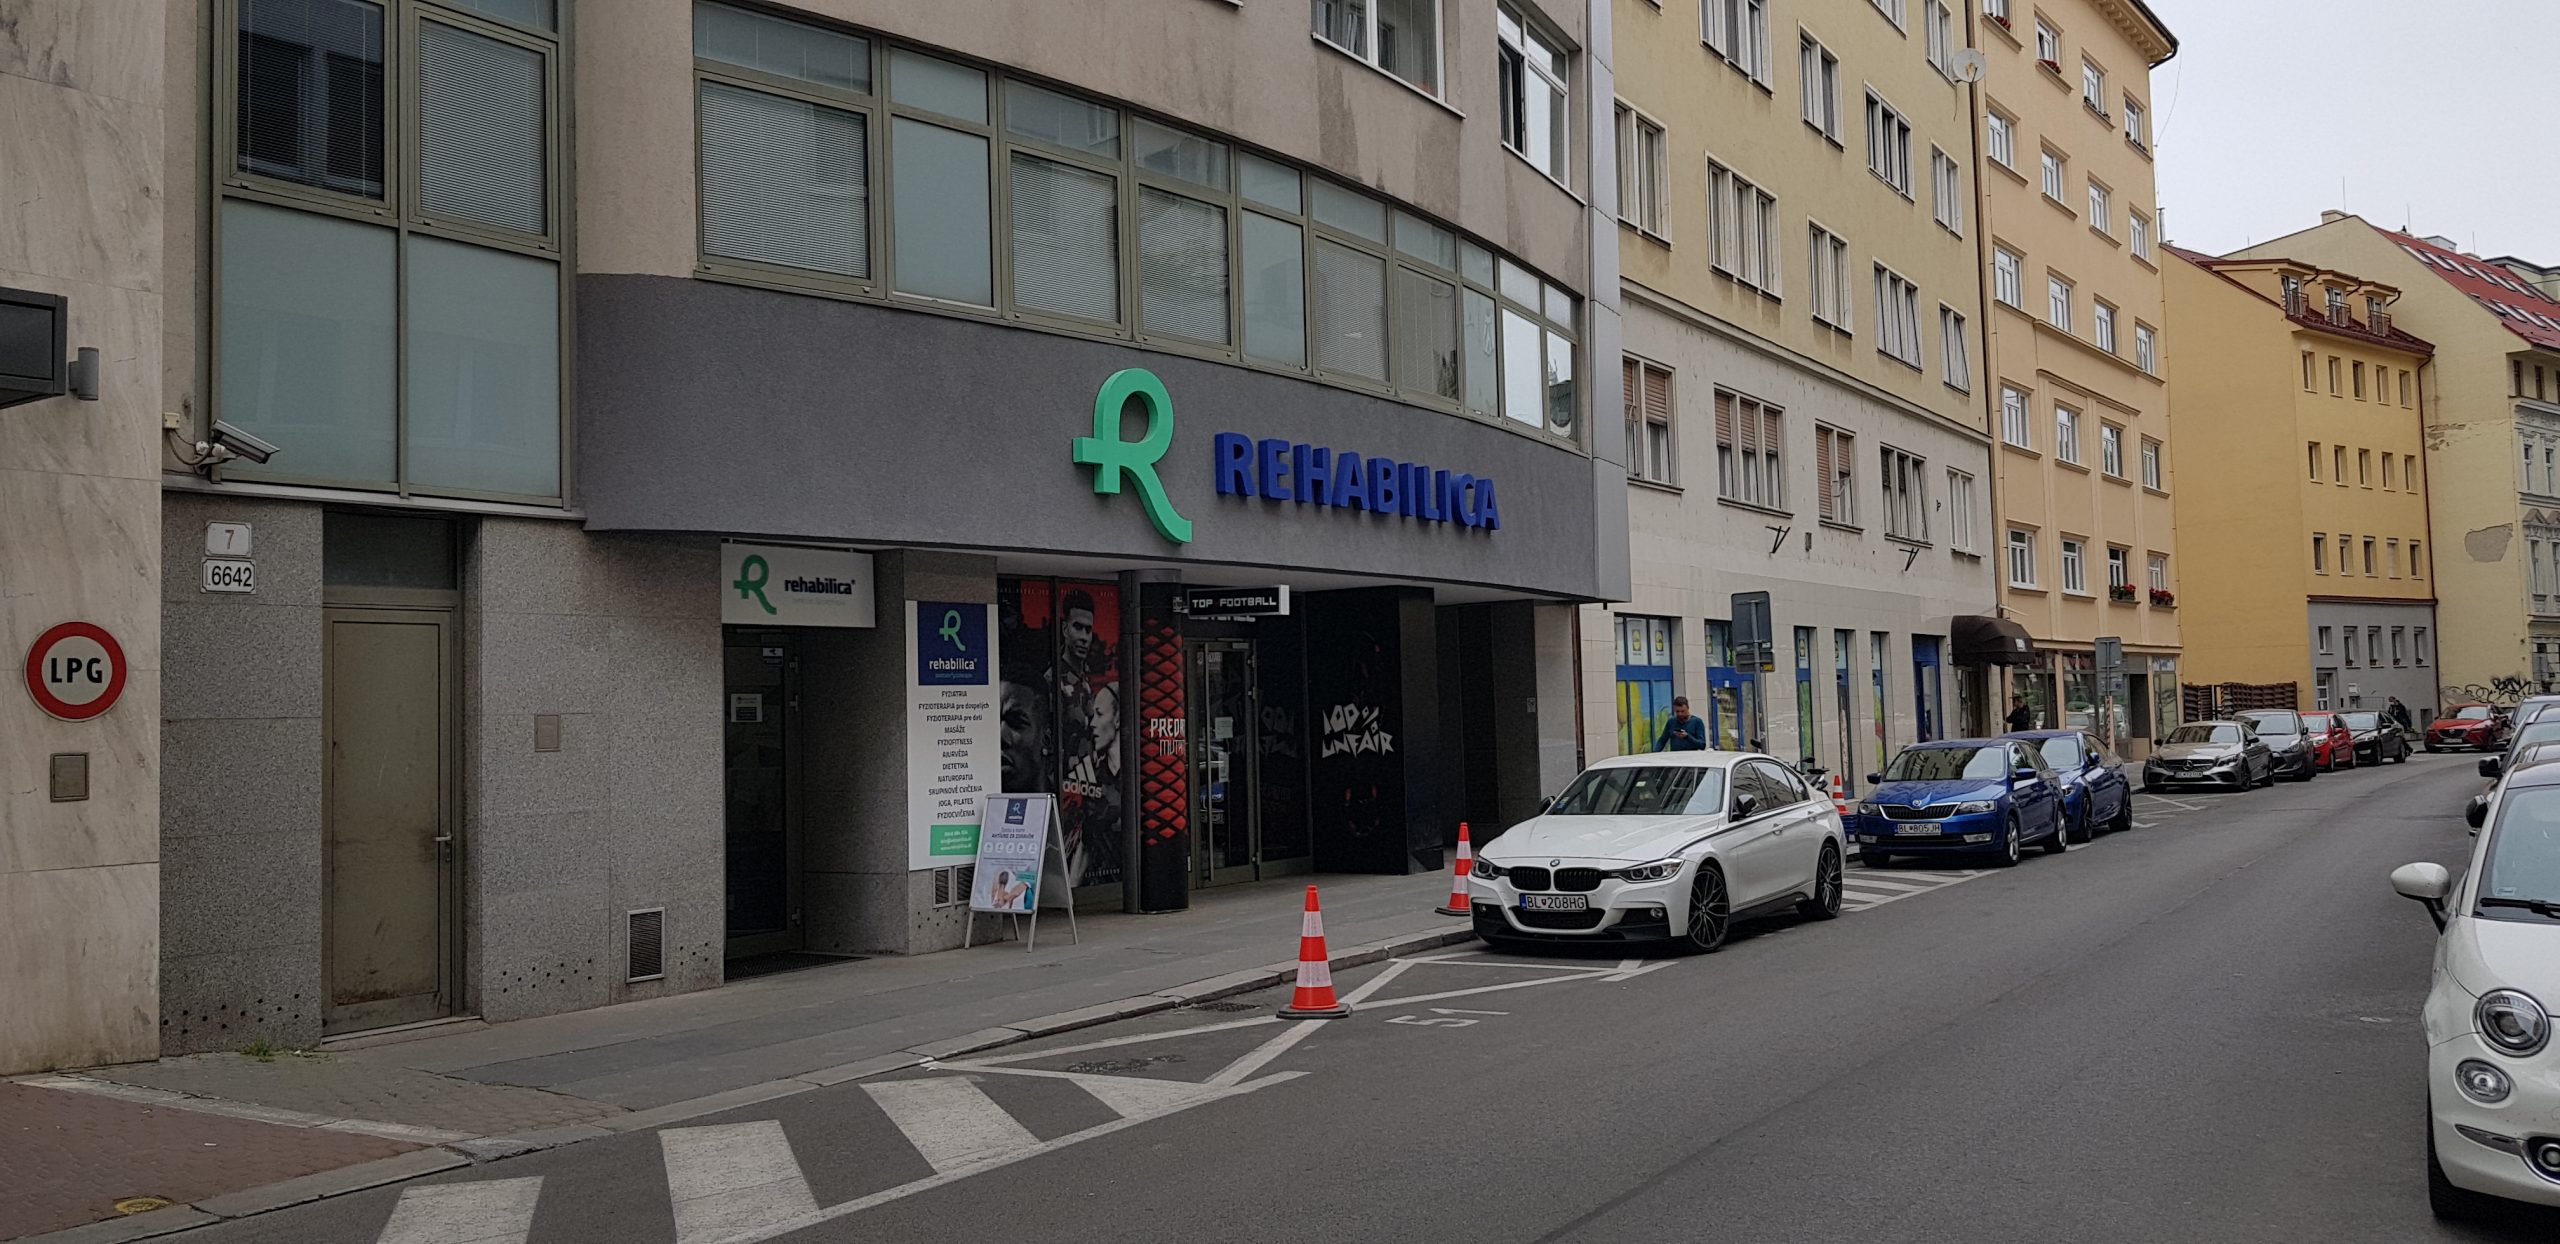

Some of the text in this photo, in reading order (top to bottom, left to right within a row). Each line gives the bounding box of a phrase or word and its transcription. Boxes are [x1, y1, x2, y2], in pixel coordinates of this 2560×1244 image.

[1214, 432, 1501, 531] REHABILICA
[225, 529, 235, 550] 7
[211, 565, 252, 587] 6642
[1192, 596, 1277, 609] TOP FOOTBALL
[50, 657, 103, 683] LPG
[937, 738, 973, 746] FYZIOFITNESS
[1321, 729, 1394, 758] UNFAIR
[942, 762, 969, 770] DIETETIKA
[938, 774, 974, 782] NATUROPATIA
[1063, 779, 1103, 798] adidas
[953, 797, 974, 805] PILATES
